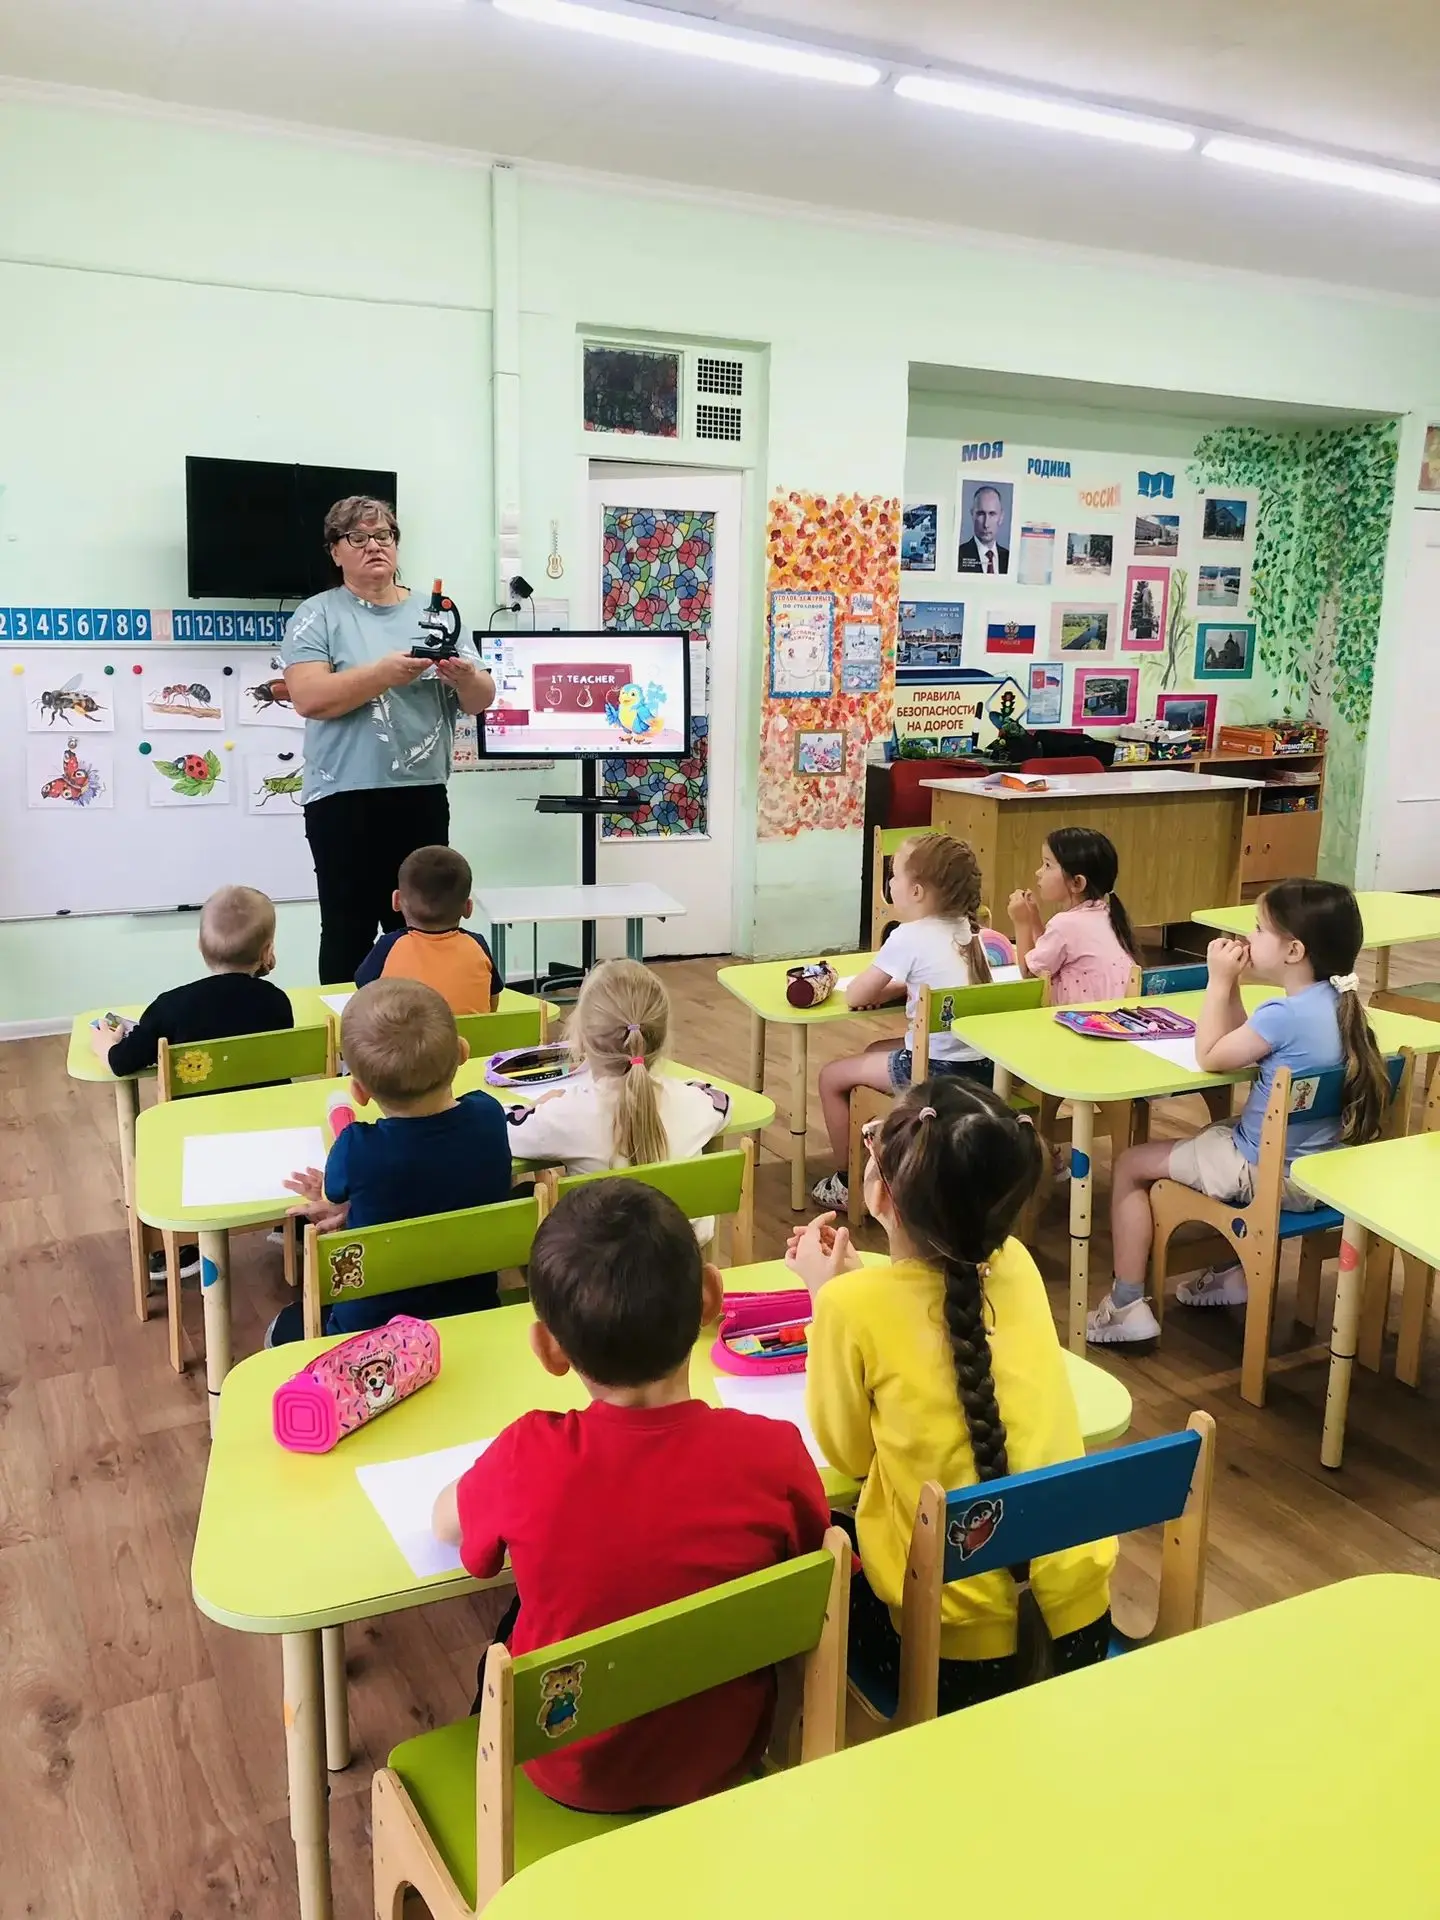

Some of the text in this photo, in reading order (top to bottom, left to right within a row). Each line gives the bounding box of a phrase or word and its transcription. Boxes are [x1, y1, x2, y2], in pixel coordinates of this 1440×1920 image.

[961, 441, 1004, 462] МОЯ
[1027, 457, 1071, 478] РОДИНА
[0, 613, 8, 635] 2
[16, 614, 27, 635] 3
[37, 614, 49, 635] 4
[58, 614, 68, 635] 5
[77, 614, 89, 636] 6
[97, 614, 108, 635] 7
[117, 615, 128, 636] 8
[136, 615, 147, 636] 9
[155, 614, 170, 636] 10
[174, 615, 191, 636] 11
[196, 616, 213, 636] 12
[216, 616, 234, 636] 13
[237, 616, 255, 637] 14
[258, 617, 275, 637] 15
[551, 675, 615, 684] IT TEACHER
[913, 691, 961, 702] ПРАВИЛА
[896, 705, 975, 717] БЕЗОПАСНОСТИ
[907, 719, 964, 733] НА ДОРОГЕ
